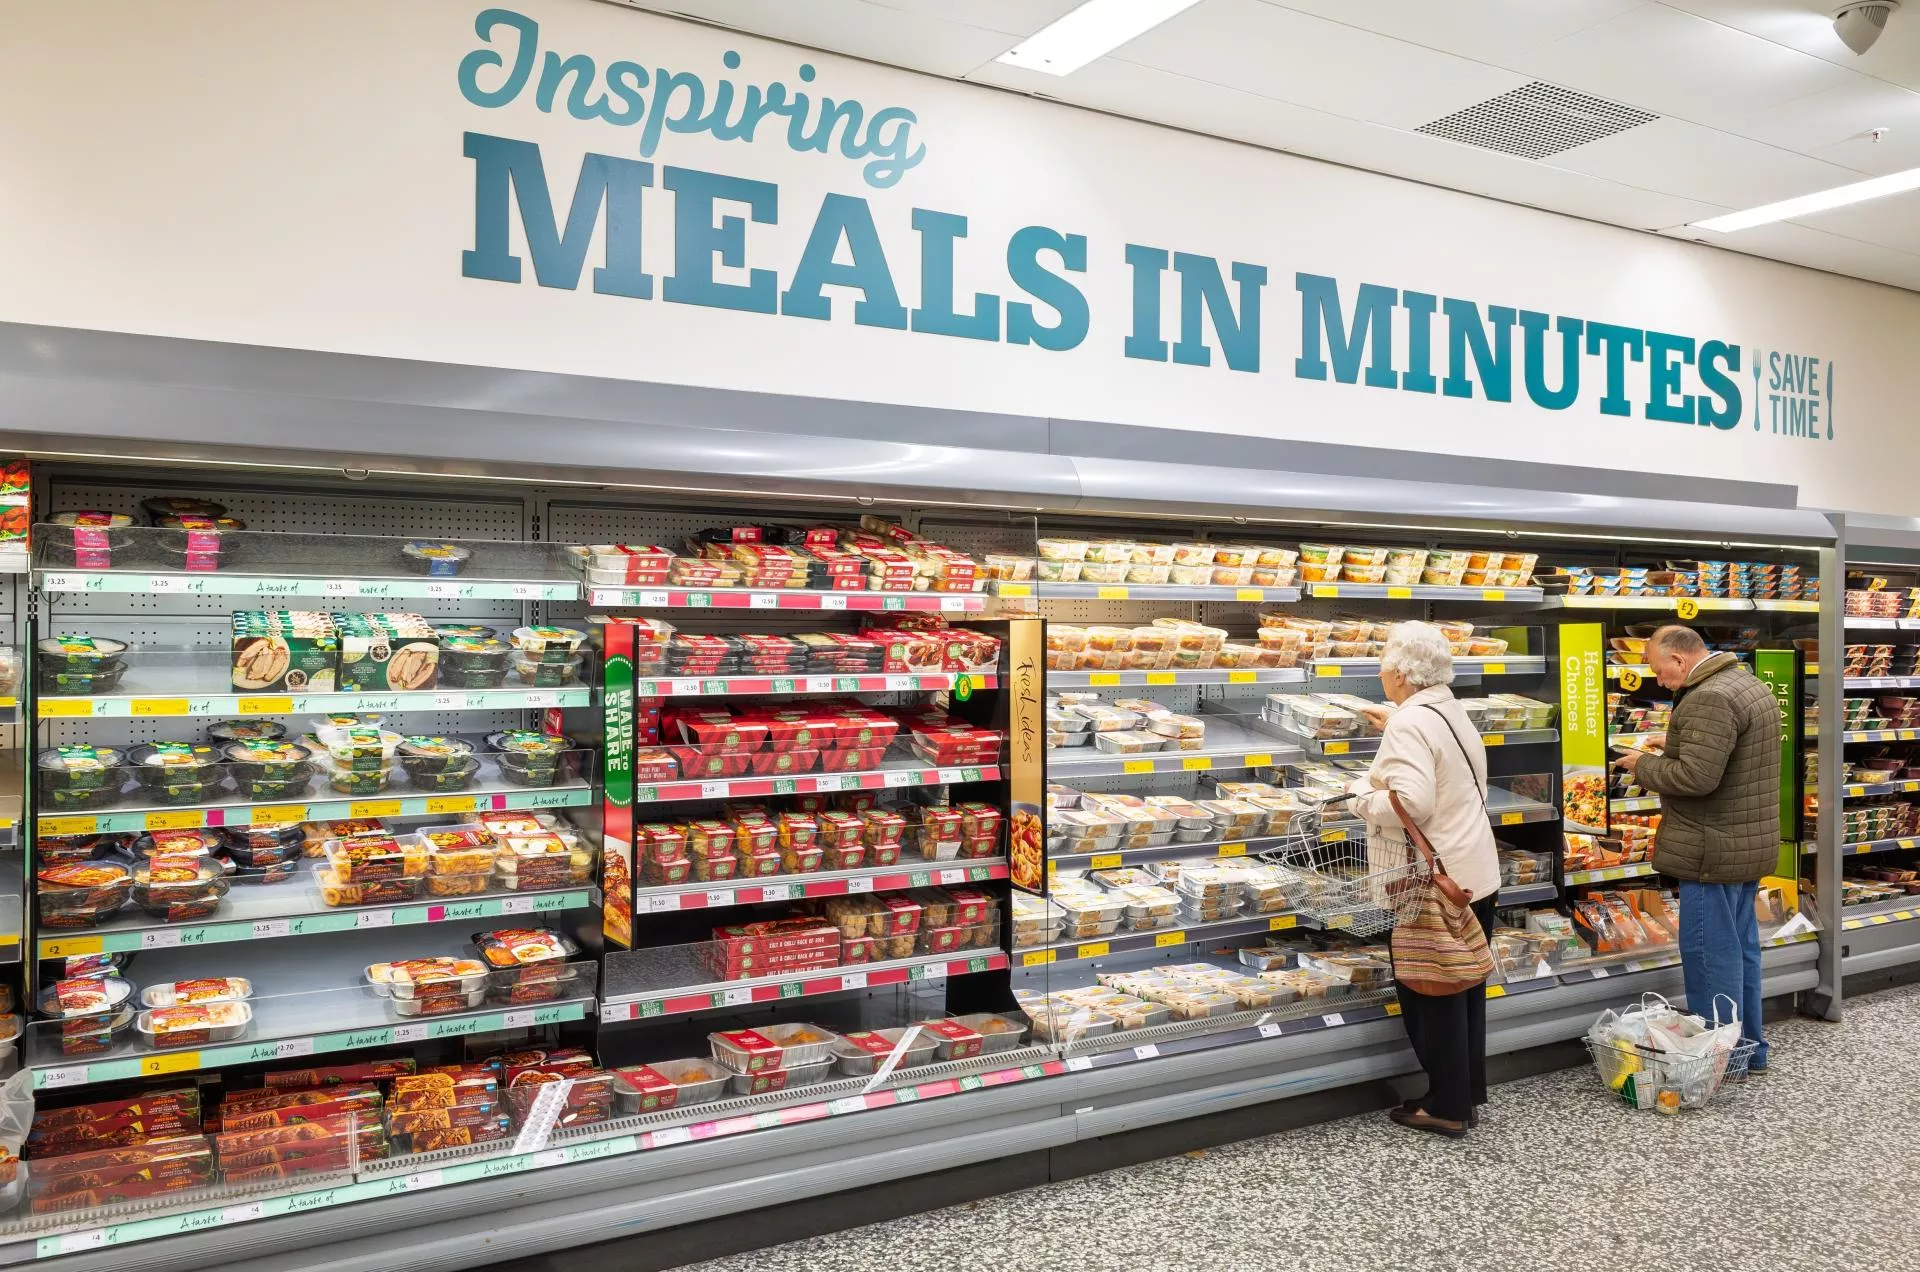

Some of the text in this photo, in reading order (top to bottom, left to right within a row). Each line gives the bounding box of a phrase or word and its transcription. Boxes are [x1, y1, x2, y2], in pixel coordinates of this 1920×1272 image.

[458, 8, 926, 189] Inspiring
[462, 131, 1742, 430] MEALS IN MINUTES
[1769, 351, 1819, 396] SAVE
[1769, 394, 1819, 439] TIME
[1682, 602, 1693, 616] £2
[1016, 656, 1037, 764] Fresh ideas
[1566, 656, 1581, 731] Choices
[1584, 651, 1600, 737] Healthier
[1624, 672, 1637, 687] £2
[605, 692, 621, 772] SHARE
[619, 688, 633, 771] MADE TO
[50, 945, 60, 954] £2
[150, 1062, 160, 1071] £2
